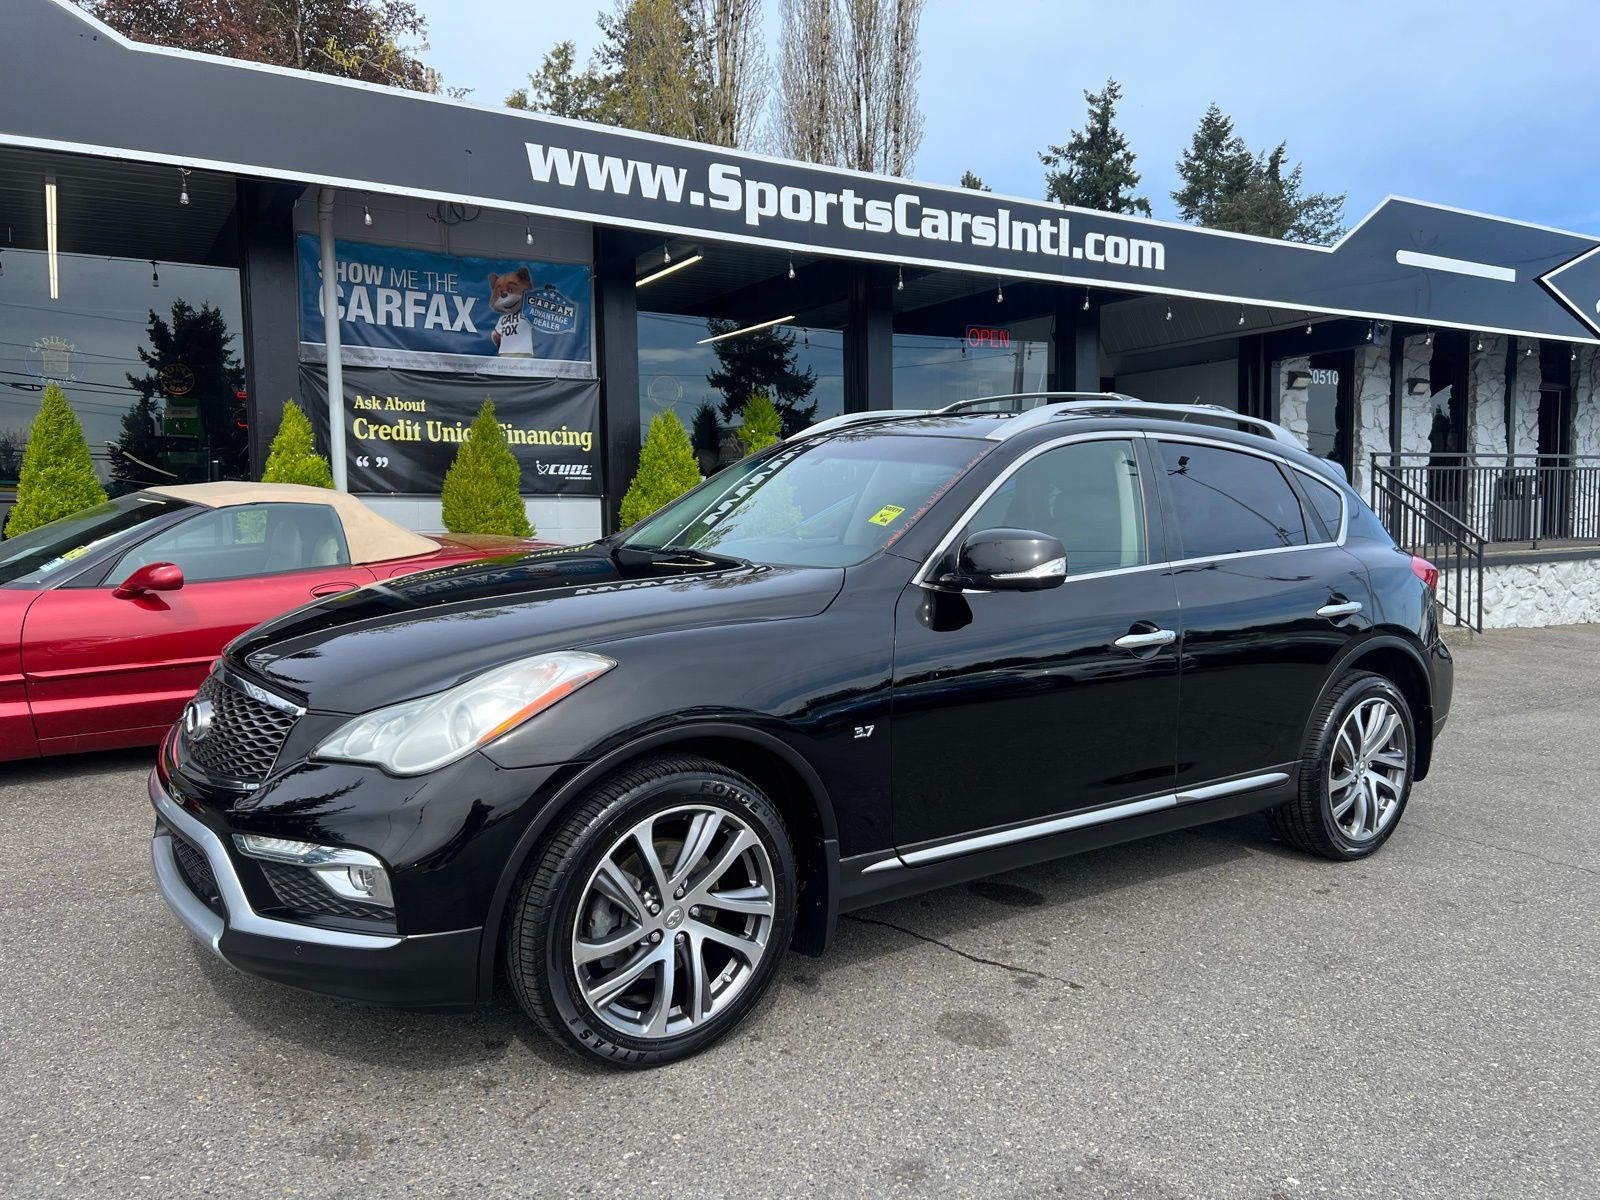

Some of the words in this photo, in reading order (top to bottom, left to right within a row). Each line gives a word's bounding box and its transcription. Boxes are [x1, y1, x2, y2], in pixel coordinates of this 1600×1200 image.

[318, 261, 384, 285] HOW
[390, 267, 419, 290] ME
[424, 271, 458, 294] THE
[528, 297, 573, 317] CARFAX
[529, 307, 569, 325] ADVANTAGE
[501, 313, 519, 326] CAR
[533, 317, 560, 331] DEALER
[501, 324, 518, 337] FOX
[968, 328, 1010, 348] OPEN
[353, 395, 382, 410] Ask
[384, 396, 426, 412] About
[352, 417, 421, 442] Credit
[854, 725, 875, 739] 3.7
[699, 781, 761, 813] FORCE
[578, 1029, 648, 1062] ATLAS
